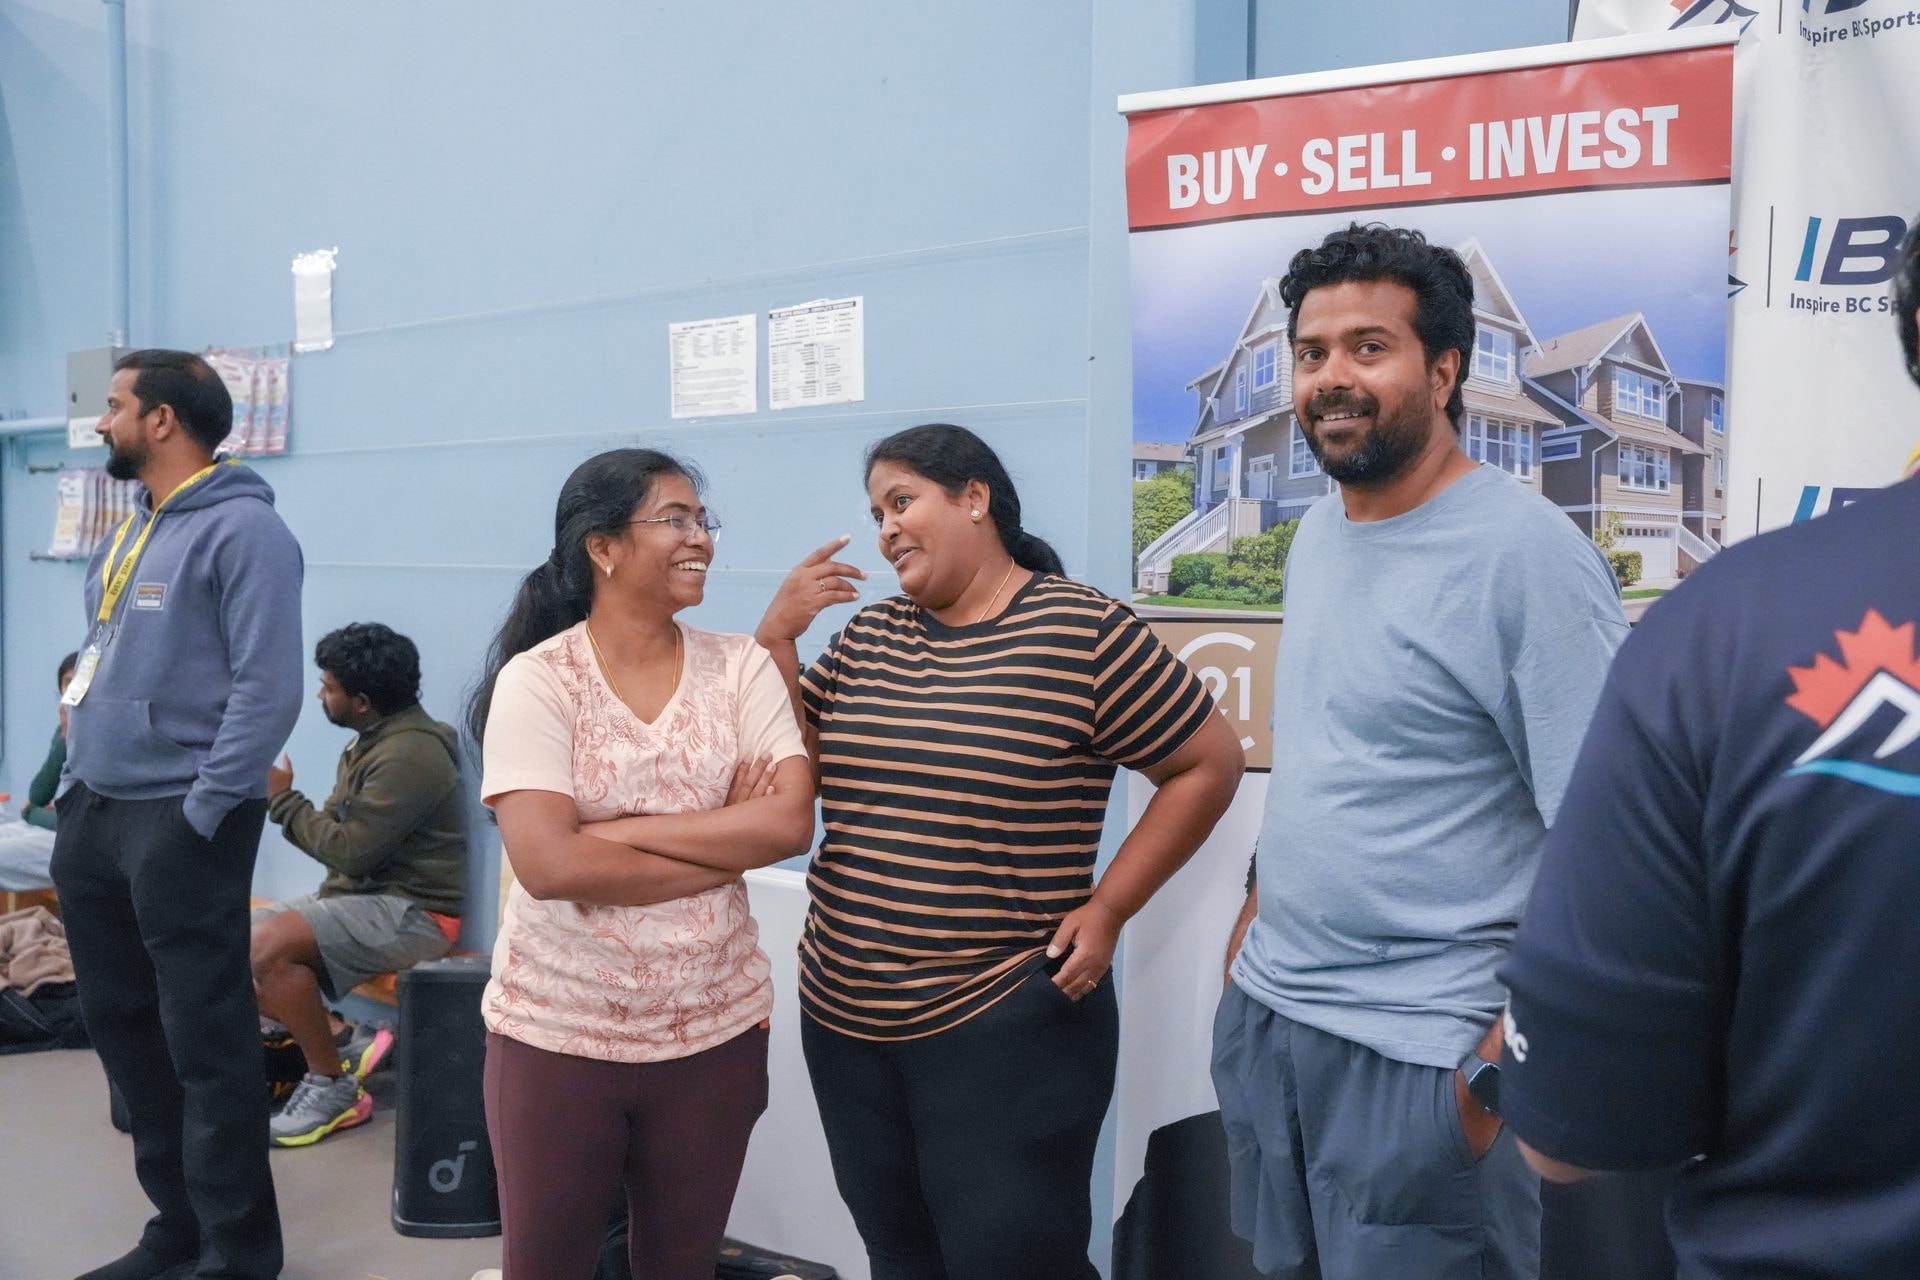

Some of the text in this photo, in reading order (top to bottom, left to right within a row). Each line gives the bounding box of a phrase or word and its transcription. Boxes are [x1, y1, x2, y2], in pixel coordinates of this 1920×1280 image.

[1799, 20, 1848, 47] Inspire
[1167, 104, 1679, 210] BUY SELL INVEST
[1790, 292, 1840, 315] Inspire
[1845, 296, 1872, 313] BC
